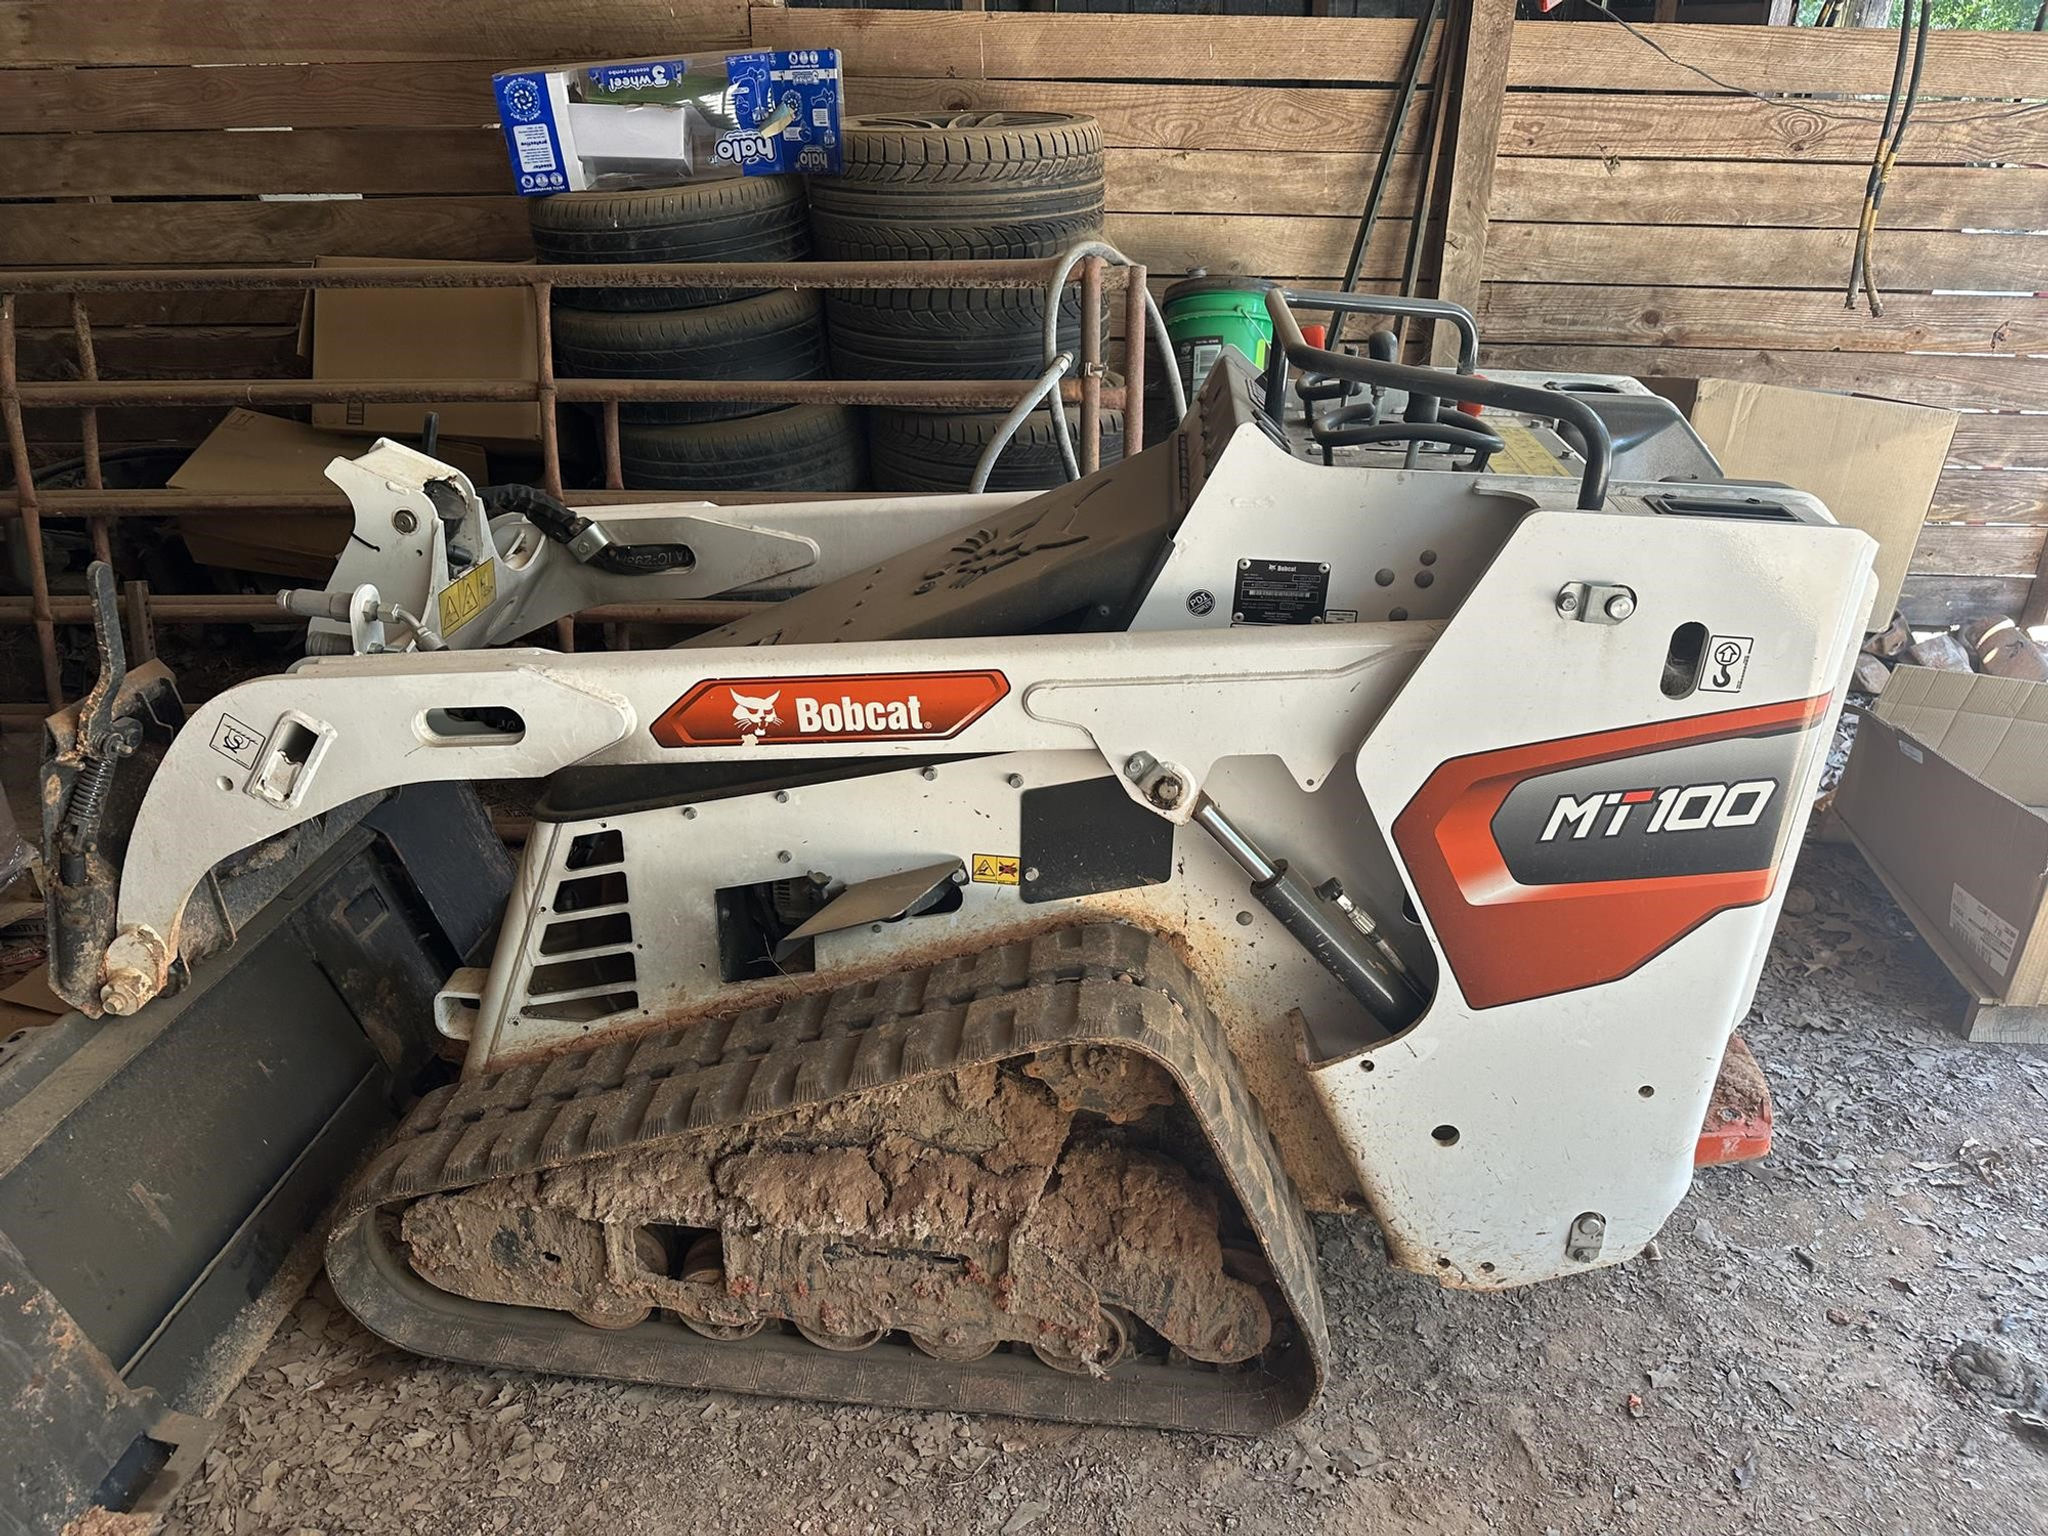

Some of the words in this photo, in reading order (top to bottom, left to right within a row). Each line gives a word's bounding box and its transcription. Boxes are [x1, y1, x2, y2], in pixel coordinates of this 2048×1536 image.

[609, 75, 652, 91] wheel
[652, 65, 668, 86] 3
[716, 136, 775, 164] halo
[799, 150, 829, 169] halo
[1277, 564, 1297, 573] Bobcat
[1189, 592, 1209, 608] PDI
[796, 695, 923, 733] Bobcat
[1540, 780, 1777, 841] MT100
